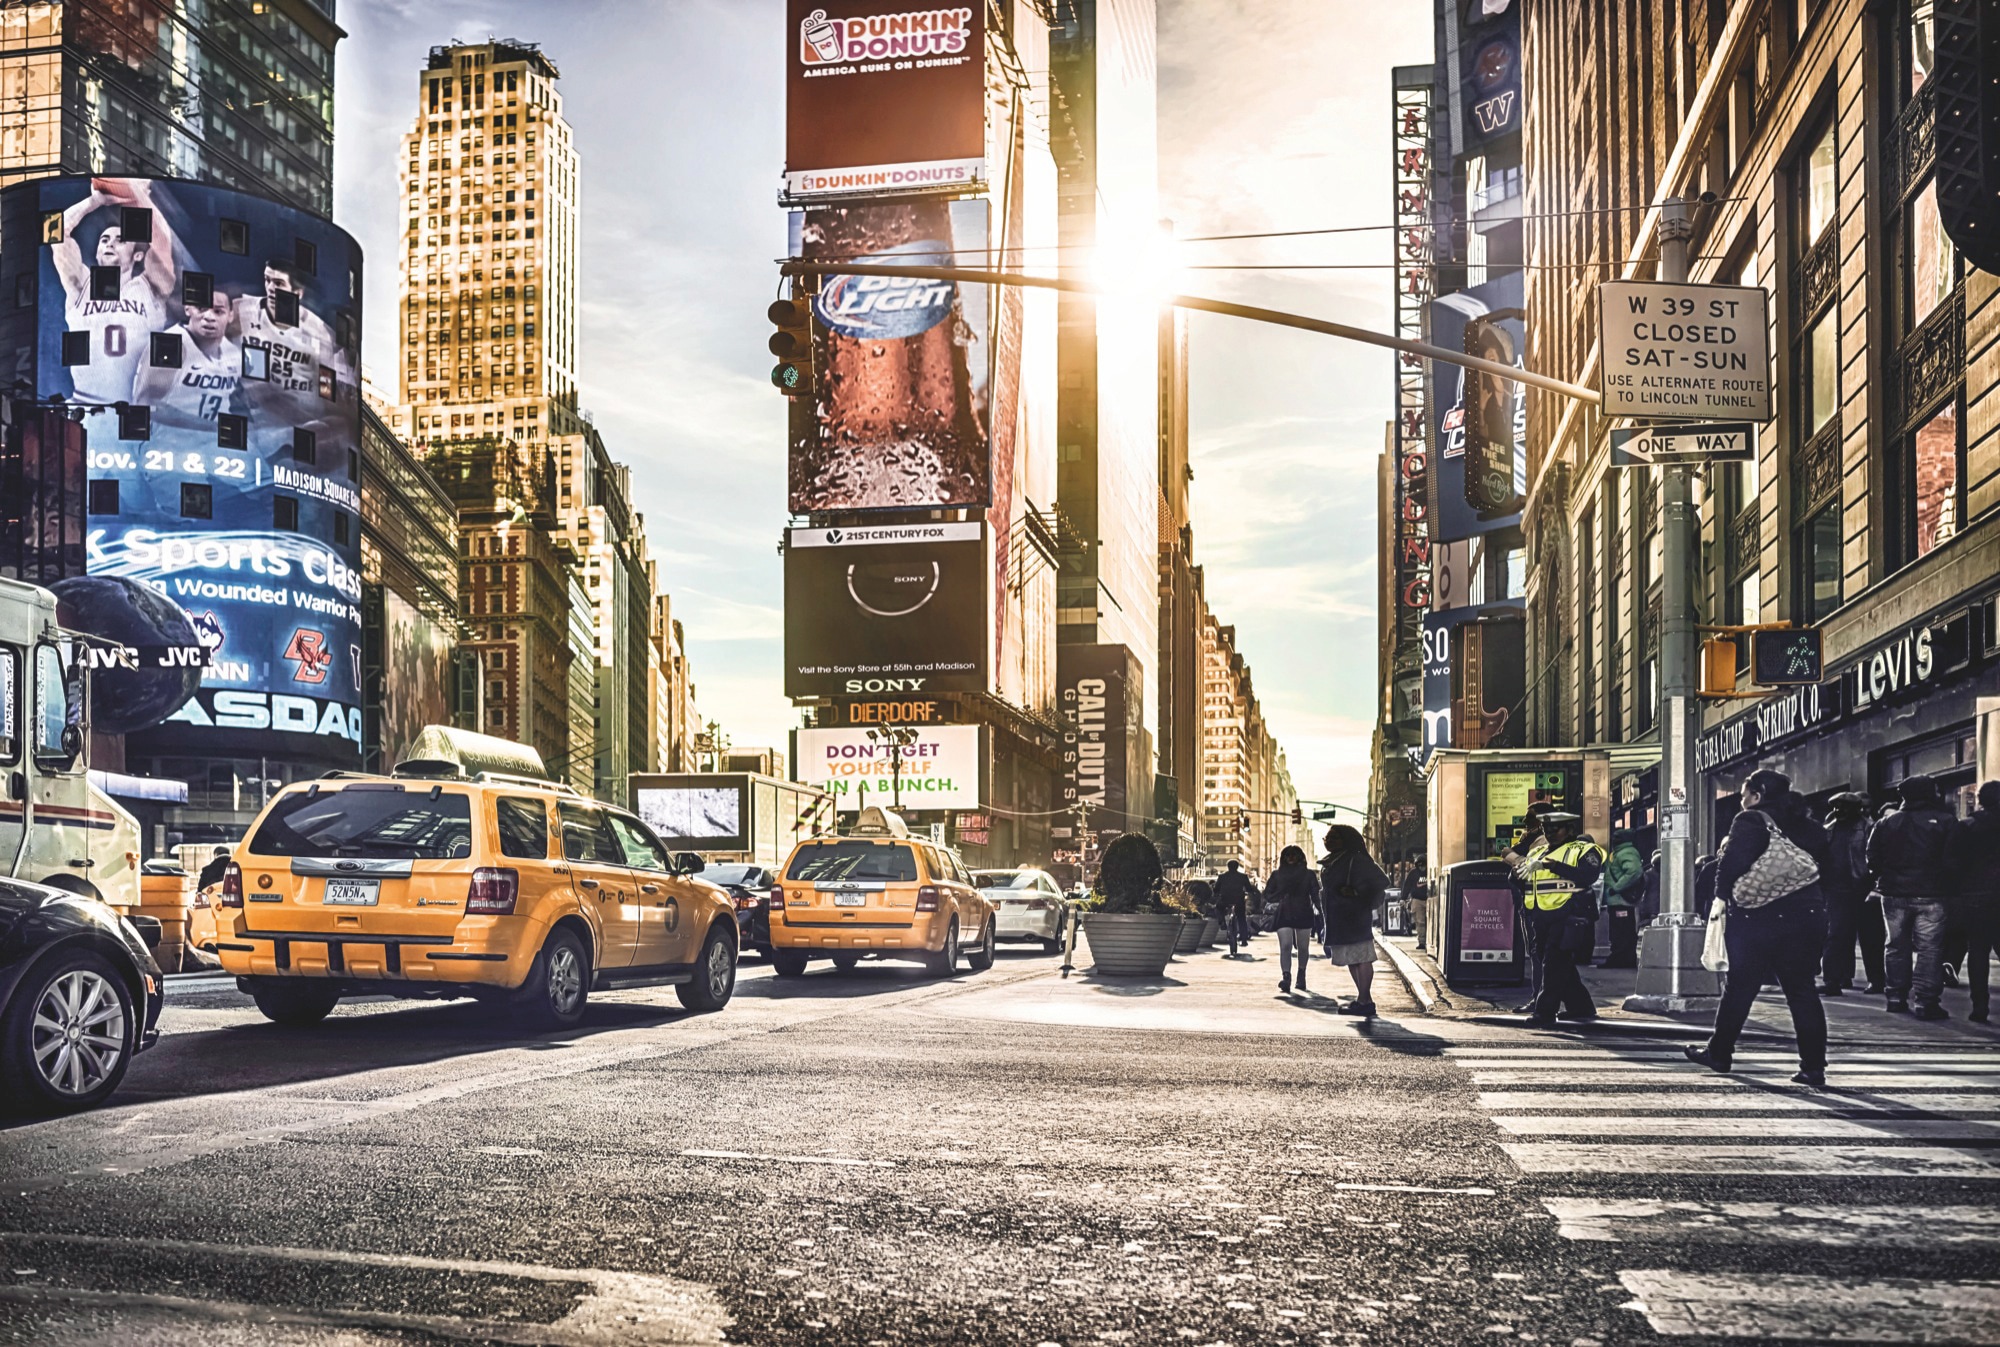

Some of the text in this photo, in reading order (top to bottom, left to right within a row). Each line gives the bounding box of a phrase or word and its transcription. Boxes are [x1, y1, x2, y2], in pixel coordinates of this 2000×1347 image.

[847, 9, 972, 39] DUNKIN'
[847, 31, 965, 60] DONUTS
[803, 65, 857, 78] AMERICA
[860, 63, 891, 73] RUNS
[894, 61, 912, 71] ON
[82, 299, 147, 318] INDIANA
[837, 285, 952, 314] LIGHT
[1628, 296, 1739, 318] W 39 ST
[104, 325, 126, 357] 0
[1634, 323, 1737, 345] CLOSED
[1625, 348, 1747, 371] SAT-SUN
[182, 371, 241, 390] UCONN
[1607, 374, 1764, 392] USE ALTERNATE ROUTE
[1617, 391, 1756, 408] TO LINCOLN TUNNEL
[1482, 447, 1497, 460] THE
[1489, 441, 1505, 455] SEE
[1637, 435, 1738, 453] ONE WAY
[144, 450, 174, 471] 21
[183, 452, 206, 474] &
[214, 456, 246, 478] 22
[1489, 459, 1511, 474] SHOW
[273, 464, 322, 493] MADISON
[324, 477, 350, 505] SQUARE
[872, 530, 922, 540] CENTURY
[923, 528, 944, 537] FOX
[123, 529, 291, 576] Sports
[894, 575, 926, 583] SONY
[175, 578, 288, 608] Wounded
[293, 590, 347, 619] Warrior
[80, 646, 201, 670] JVC JVC
[798, 667, 815, 675] Visit
[817, 666, 831, 674] the
[833, 665, 855, 674] Sony
[857, 664, 880, 672] Store
[893, 663, 912, 672] 55th
[914, 662, 932, 671] and
[935, 661, 976, 671] Madison
[845, 678, 926, 693] SONY
[1077, 678, 1106, 737] CALL
[1757, 694, 1798, 747] SHRIMP
[827, 744, 939, 759] DON'T GET
[1695, 720, 1744, 774] BUBBA GUMP
[827, 778, 959, 793] IN A BUNCH.
[1077, 742, 1106, 807] DUTY
